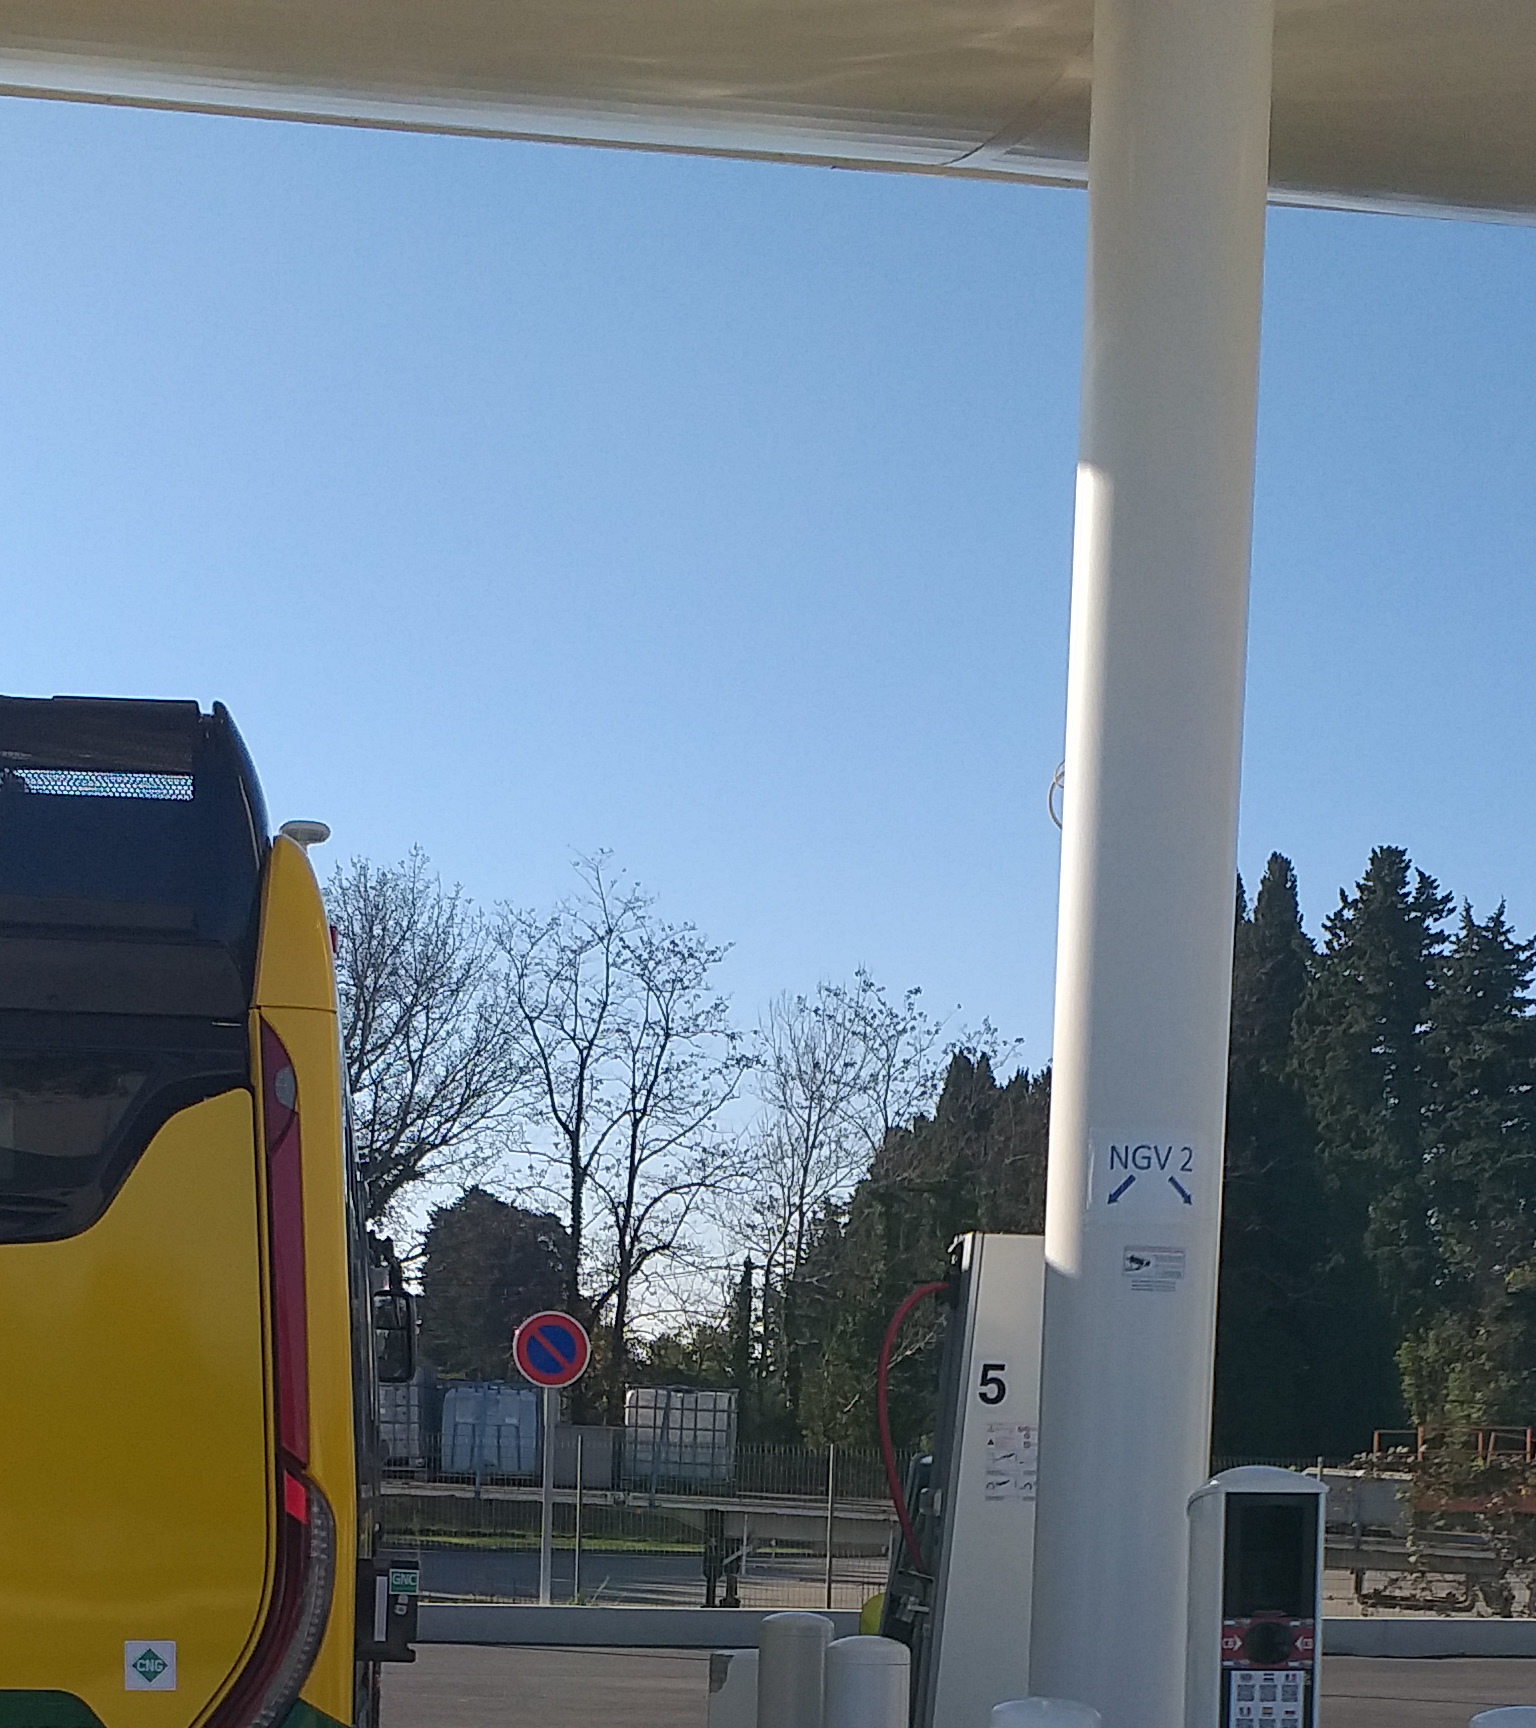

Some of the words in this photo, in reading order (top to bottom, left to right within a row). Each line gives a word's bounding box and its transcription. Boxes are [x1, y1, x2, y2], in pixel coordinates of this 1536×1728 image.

[1110, 1144, 1173, 1171] NGV
[1180, 1146, 1193, 1172] 2
[978, 1364, 1006, 1405] 5
[393, 1573, 417, 1585] GNC
[136, 1659, 164, 1672] CNG
